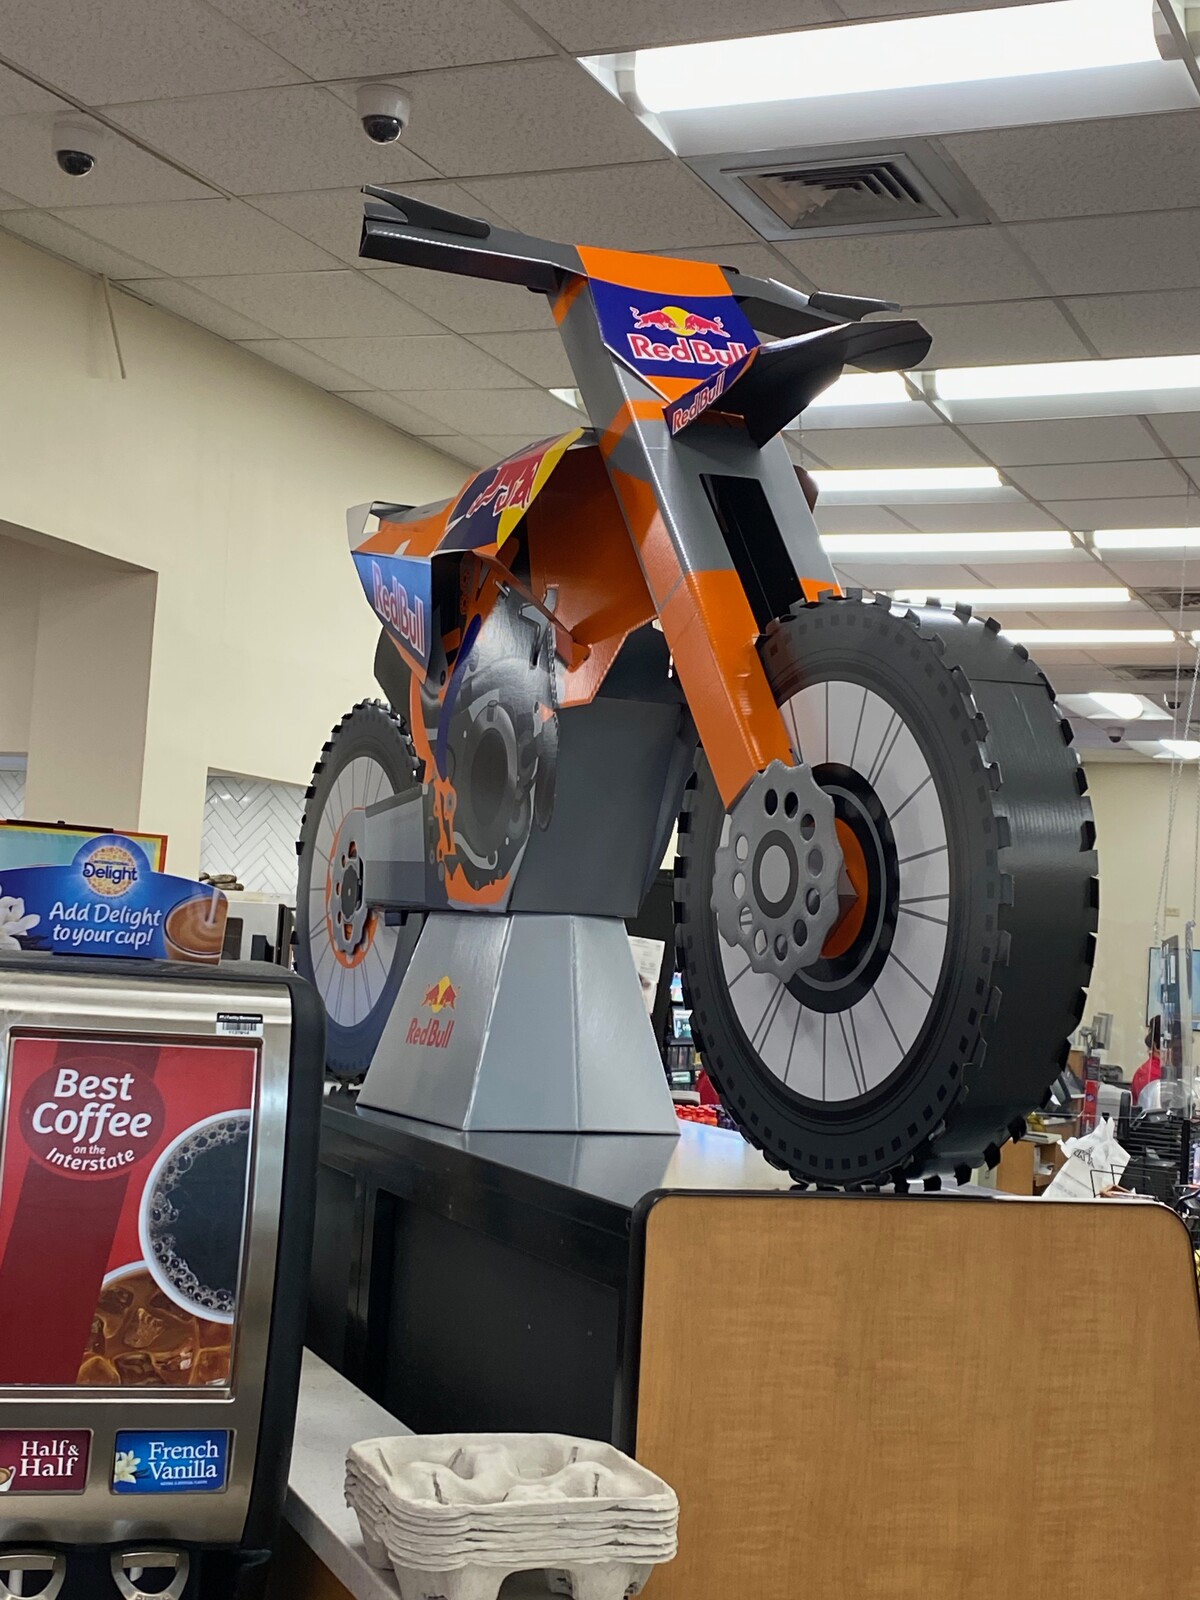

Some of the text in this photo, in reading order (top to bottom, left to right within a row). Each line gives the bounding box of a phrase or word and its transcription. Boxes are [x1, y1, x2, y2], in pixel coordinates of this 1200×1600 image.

[82, 862, 138, 884] Delight
[49, 901, 162, 930] Add Delight
[53, 923, 154, 950] to your cup!
[54, 1068, 135, 1101] Best
[32, 1102, 152, 1144] Coffee
[46, 1147, 135, 1172] Interstate
[73, 1145, 106, 1155] on the
[148, 1440, 219, 1460] French
[19, 1457, 79, 1477] Half
[148, 1459, 218, 1480] Vanilla
